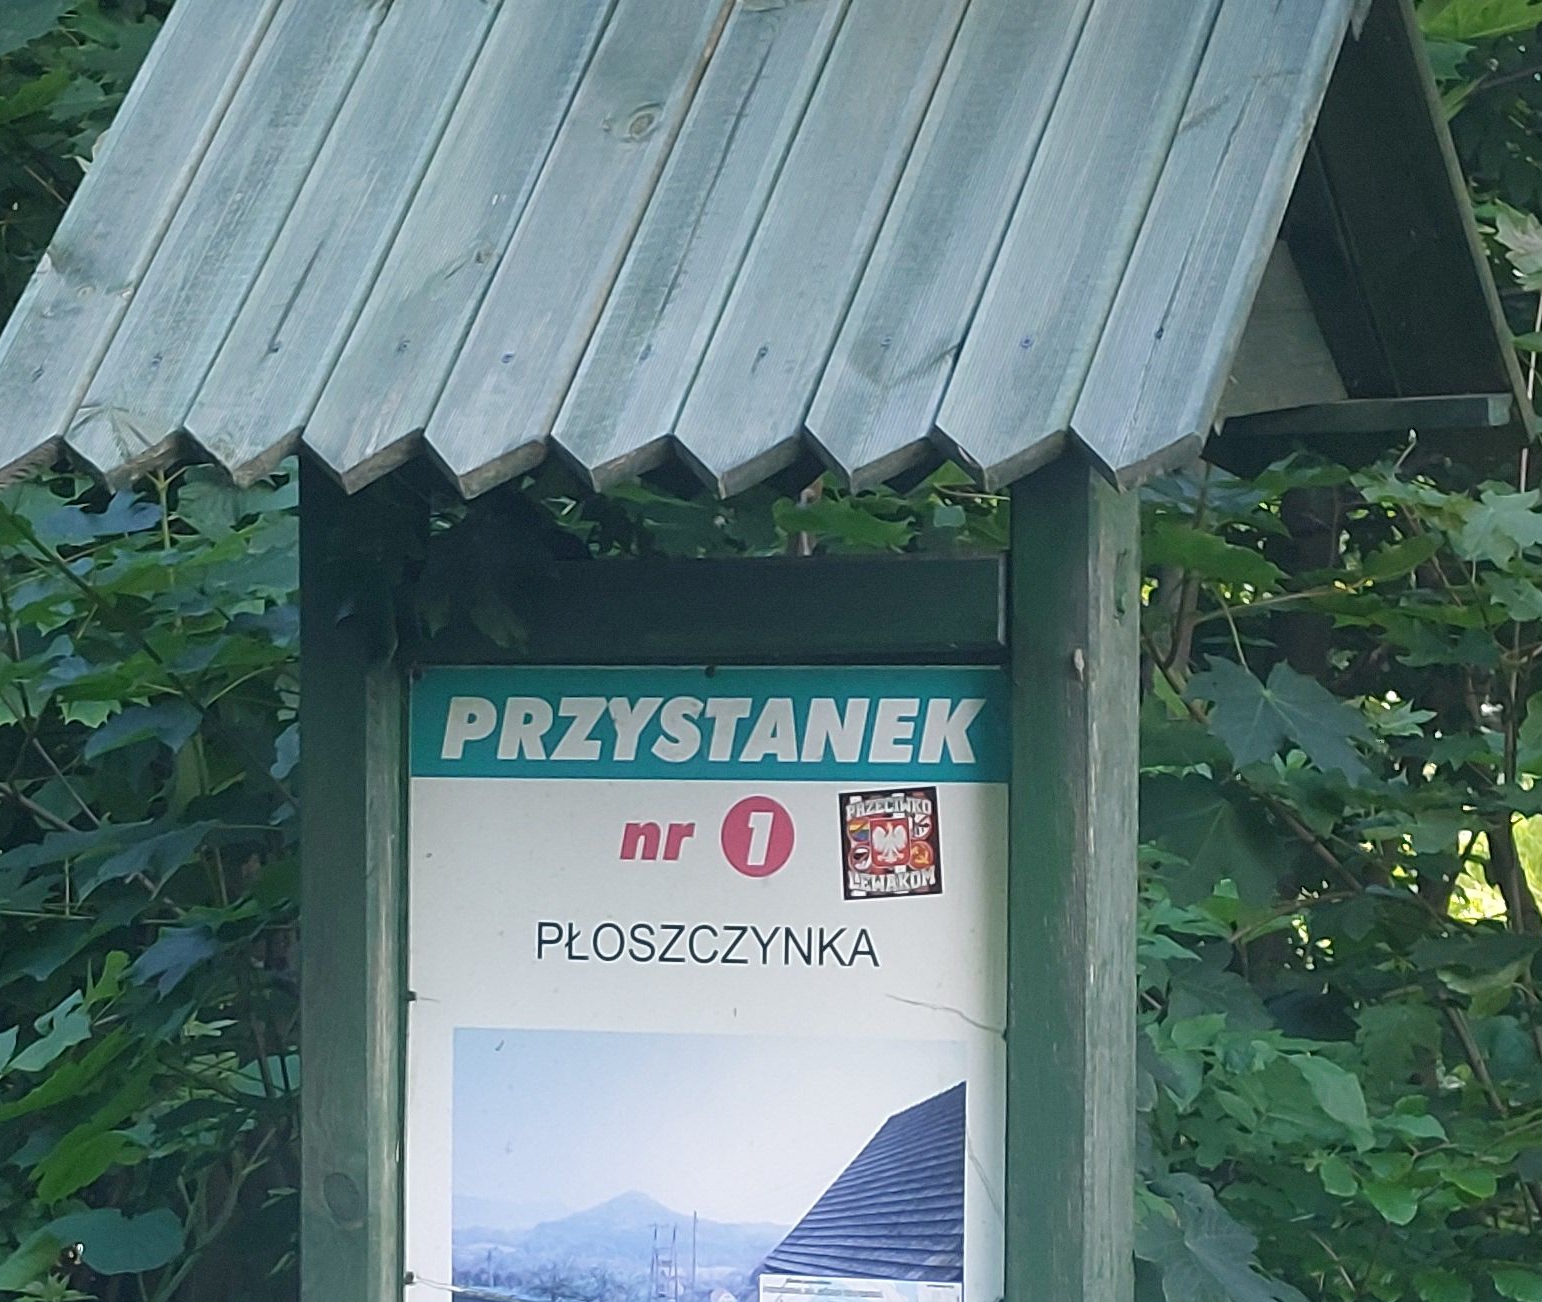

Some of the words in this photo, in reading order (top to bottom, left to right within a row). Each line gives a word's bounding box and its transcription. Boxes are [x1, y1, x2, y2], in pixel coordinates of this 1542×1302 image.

[441, 696, 987, 764] PRZYSTANEK
[619, 820, 695, 861] nr
[745, 811, 775, 866] 1
[848, 865, 936, 892] LEWAKOM
[536, 922, 880, 968] PŁOSZCZYNKA
